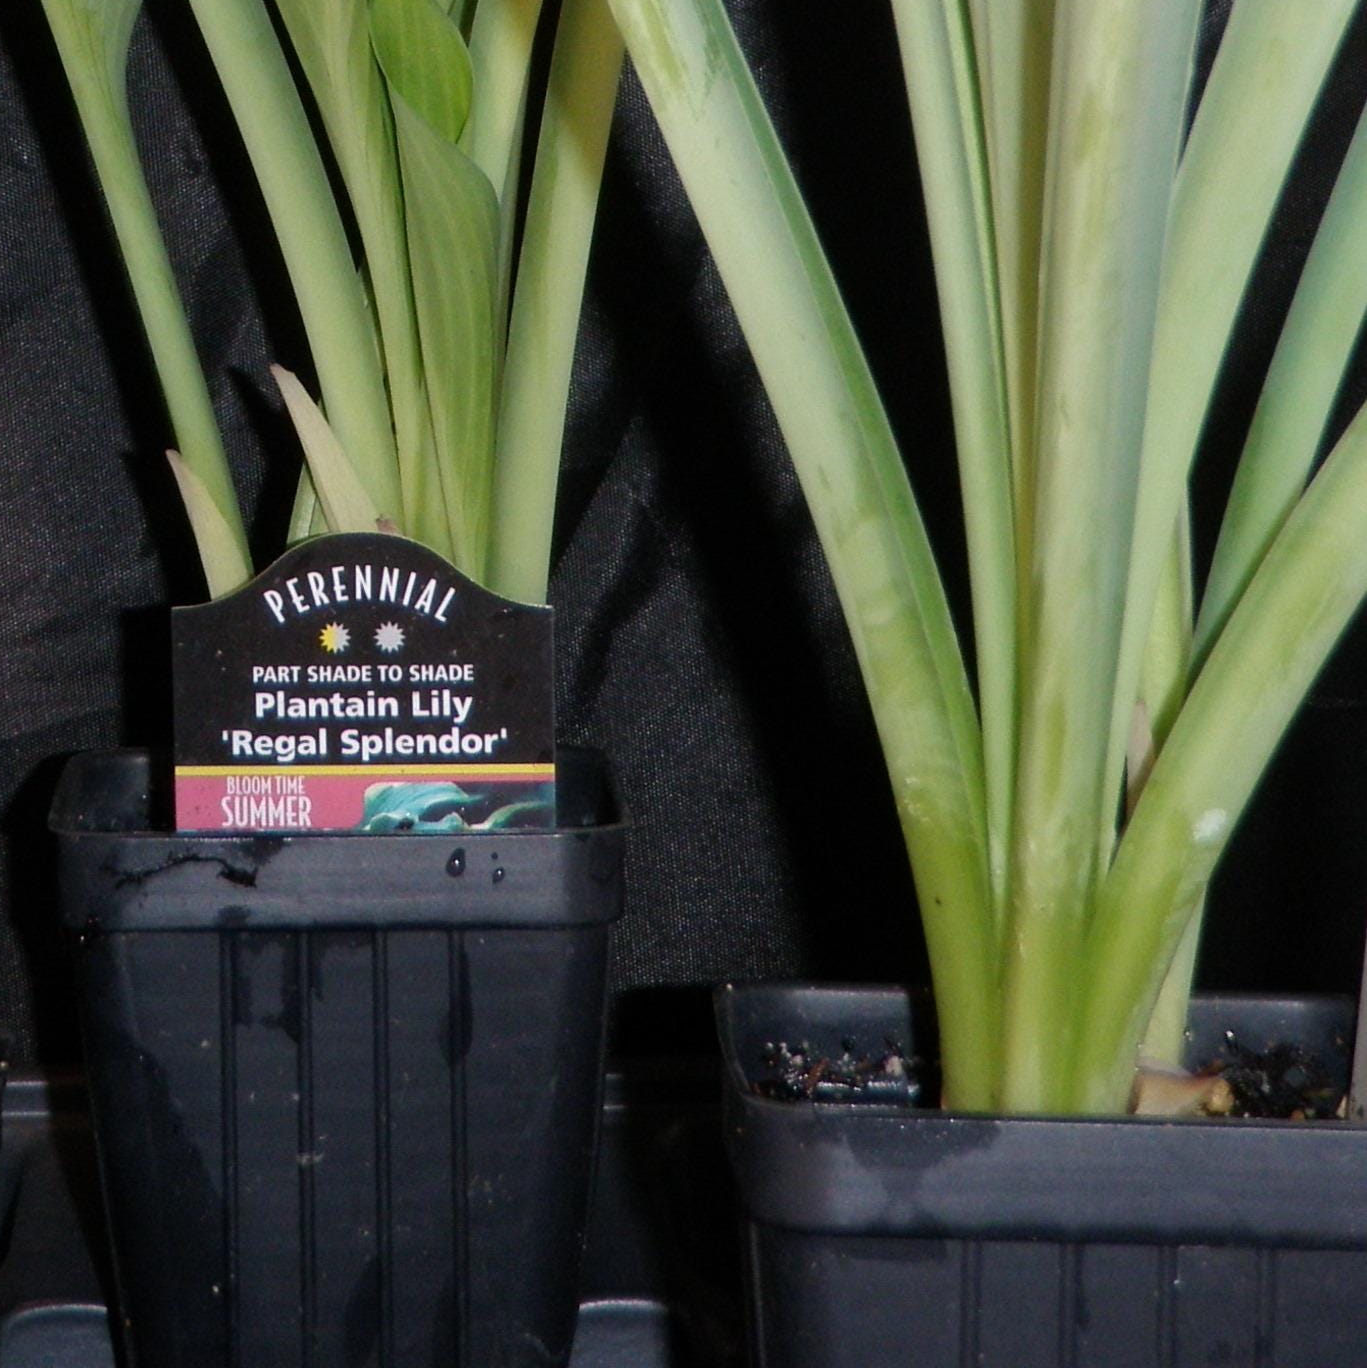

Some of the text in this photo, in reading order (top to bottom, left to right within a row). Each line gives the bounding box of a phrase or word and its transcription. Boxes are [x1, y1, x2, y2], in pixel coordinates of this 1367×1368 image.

[263, 564, 456, 623] PERENNIAL
[253, 664, 474, 683] PART SHADE TO SHADE
[255, 689, 473, 723] Plantain Lily
[222, 727, 507, 762] 'Regal Splendor'
[227, 775, 305, 795] BLOOM TIME
[221, 796, 312, 828] SUMMER
